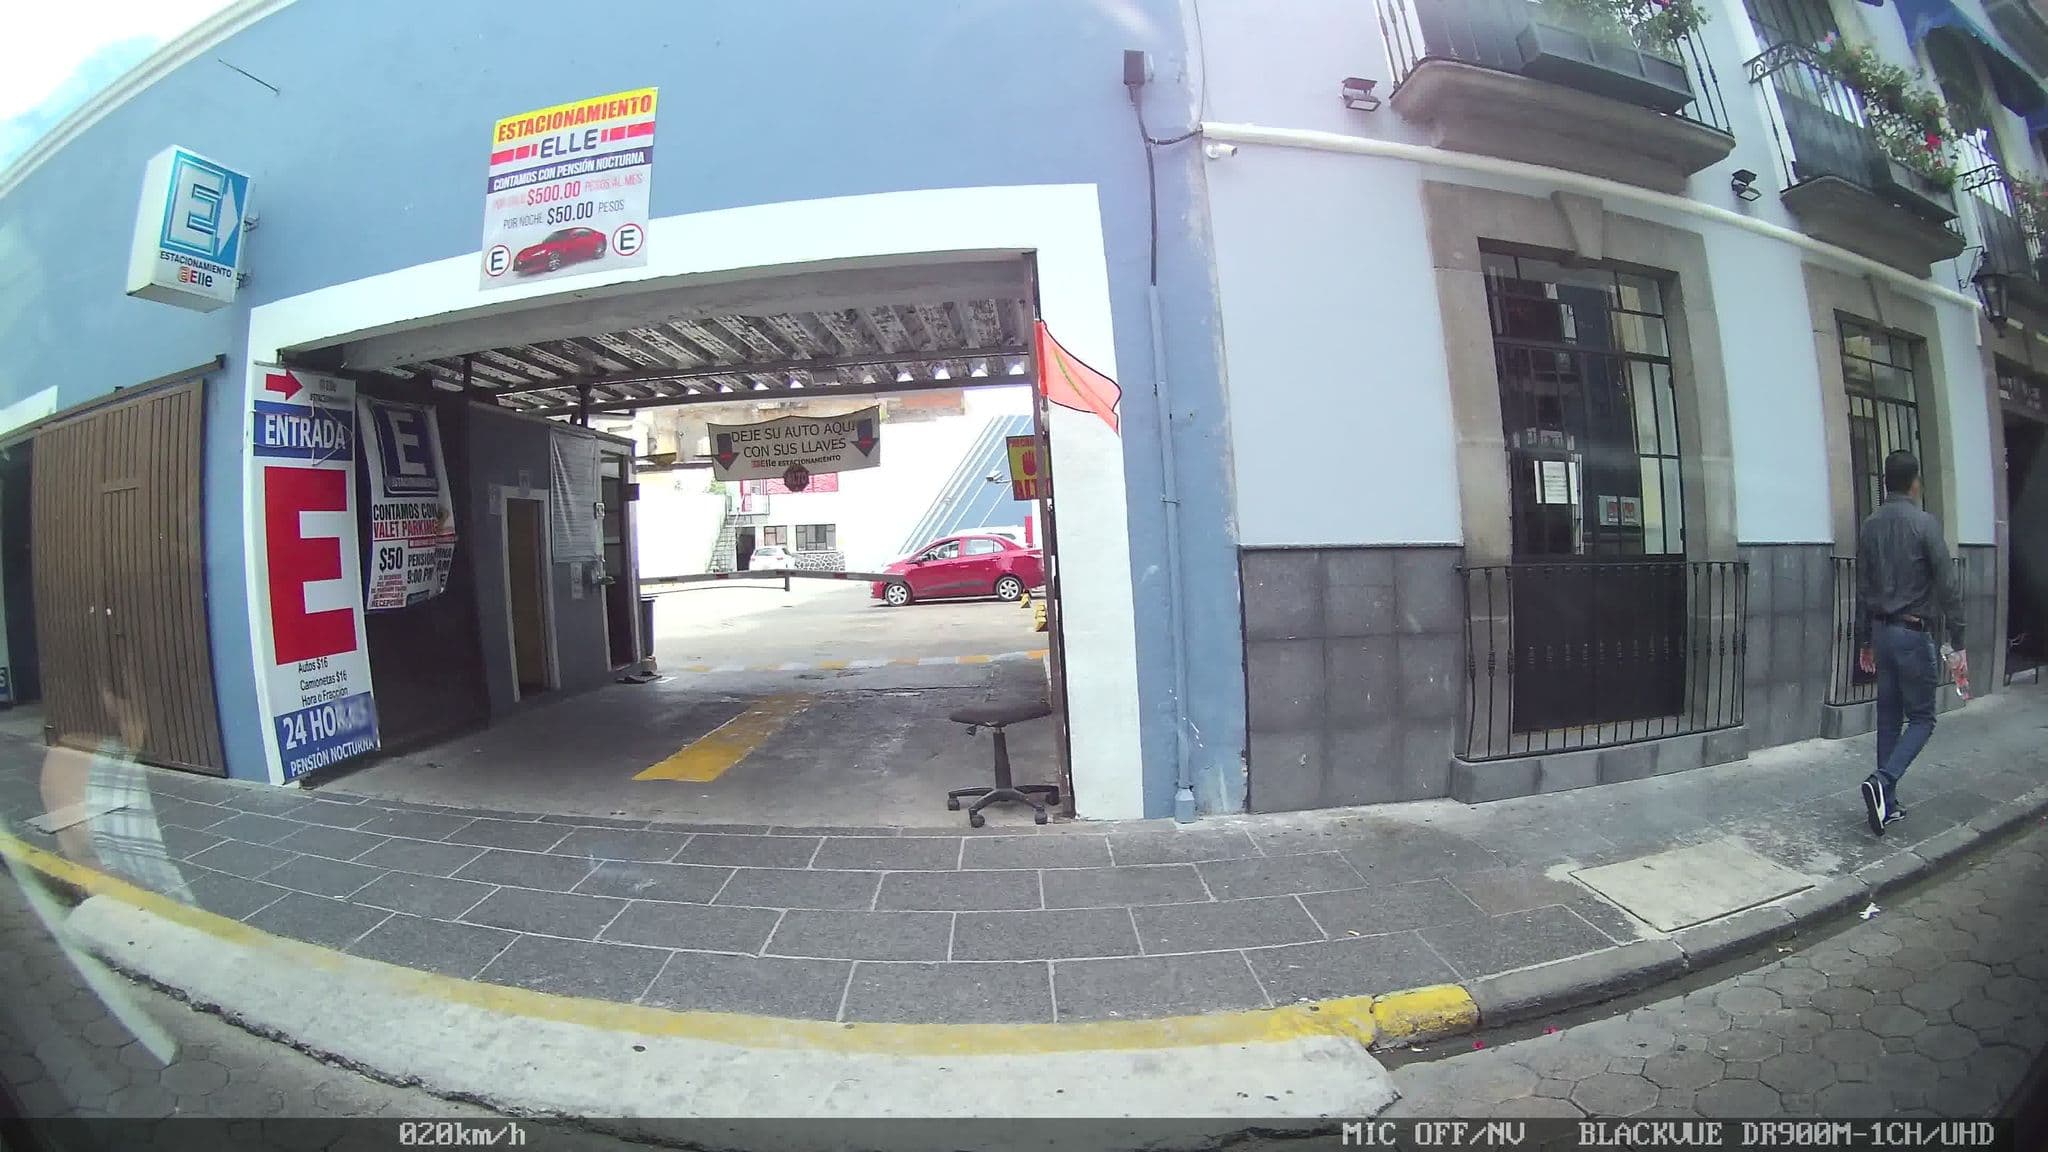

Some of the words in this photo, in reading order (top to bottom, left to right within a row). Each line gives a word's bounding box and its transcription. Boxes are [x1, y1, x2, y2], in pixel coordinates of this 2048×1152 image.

[497, 94, 652, 142] ESTACIONAMIENTO
[540, 128, 598, 159] ELLE
[493, 171, 538, 191] CONTAMOS
[538, 168, 557, 182] CON
[557, 160, 595, 178] PENSIÓN
[596, 152, 645, 170] NOCTURNA
[527, 180, 581, 206] $500.00
[165, 157, 226, 257] E
[503, 217, 517, 231] POR
[519, 213, 543, 228] NOCHE
[547, 201, 594, 226] $50.00
[598, 199, 625, 215] PESOS
[620, 229, 635, 251] E
[160, 250, 232, 278] ESTACIONAMIENTO
[490, 250, 504, 272] E
[264, 414, 346, 450] ENTRADA
[386, 411, 428, 476] E
[731, 428, 761, 443] DEJE
[765, 427, 781, 440] SU
[785, 423, 820, 439] AUTO
[743, 445, 770, 458] CON
[773, 443, 798, 456] SUS
[801, 437, 847, 454] LLAVES
[778, 454, 841, 466] ESTACIONAMIENTO
[373, 503, 420, 521] CONTAMOS
[373, 520, 400, 538] VALET
[402, 518, 438, 537] PARKING
[264, 465, 358, 666] E
[379, 546, 403, 573] $50
[298, 661, 316, 674] Autos
[300, 674, 336, 691] Camionetas
[301, 695, 317, 707] Hora
[283, 713, 307, 751] 24
[290, 747, 330, 777] PENSIÓN
[330, 739, 375, 765] NOCTURNA
